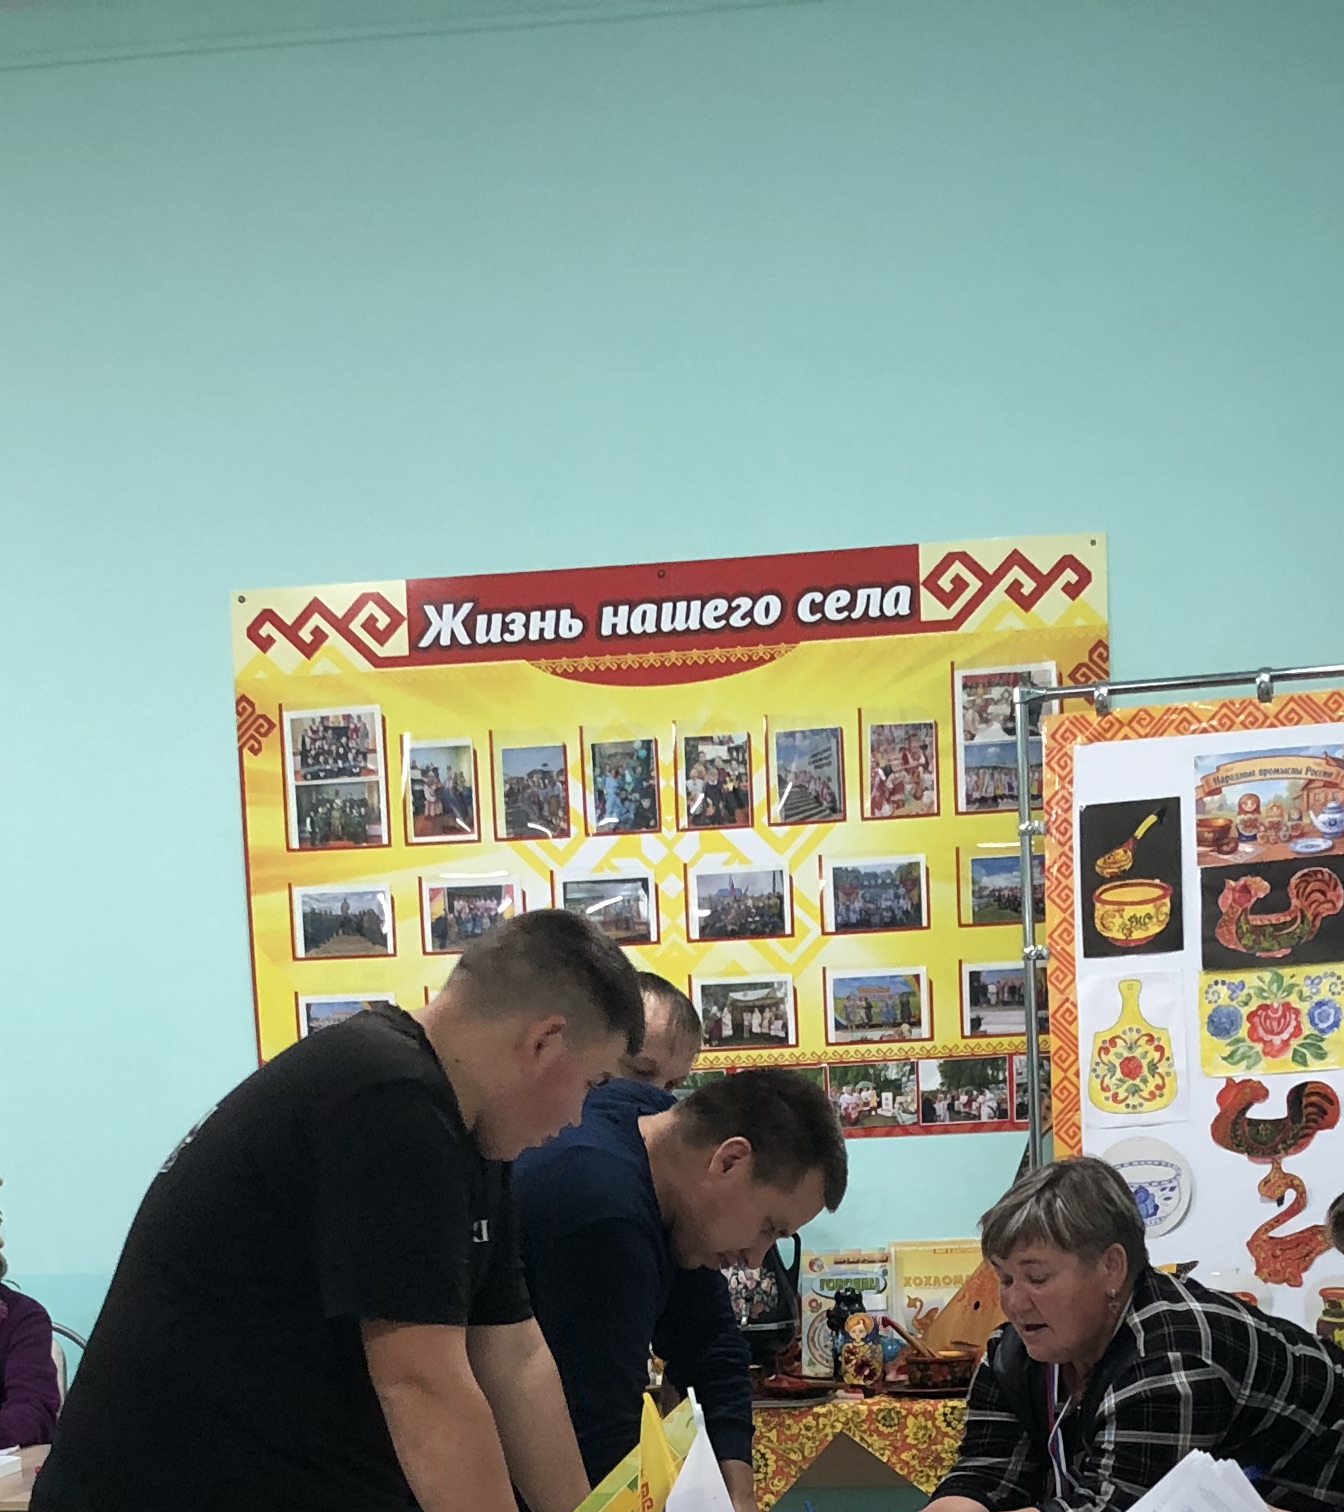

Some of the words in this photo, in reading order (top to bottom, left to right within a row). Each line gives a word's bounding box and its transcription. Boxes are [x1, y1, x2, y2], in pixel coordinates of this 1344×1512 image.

[418, 601, 584, 649] Жизнь
[600, 593, 783, 638] нашего
[796, 583, 913, 624] села
[1305, 766, 1334, 779] России
